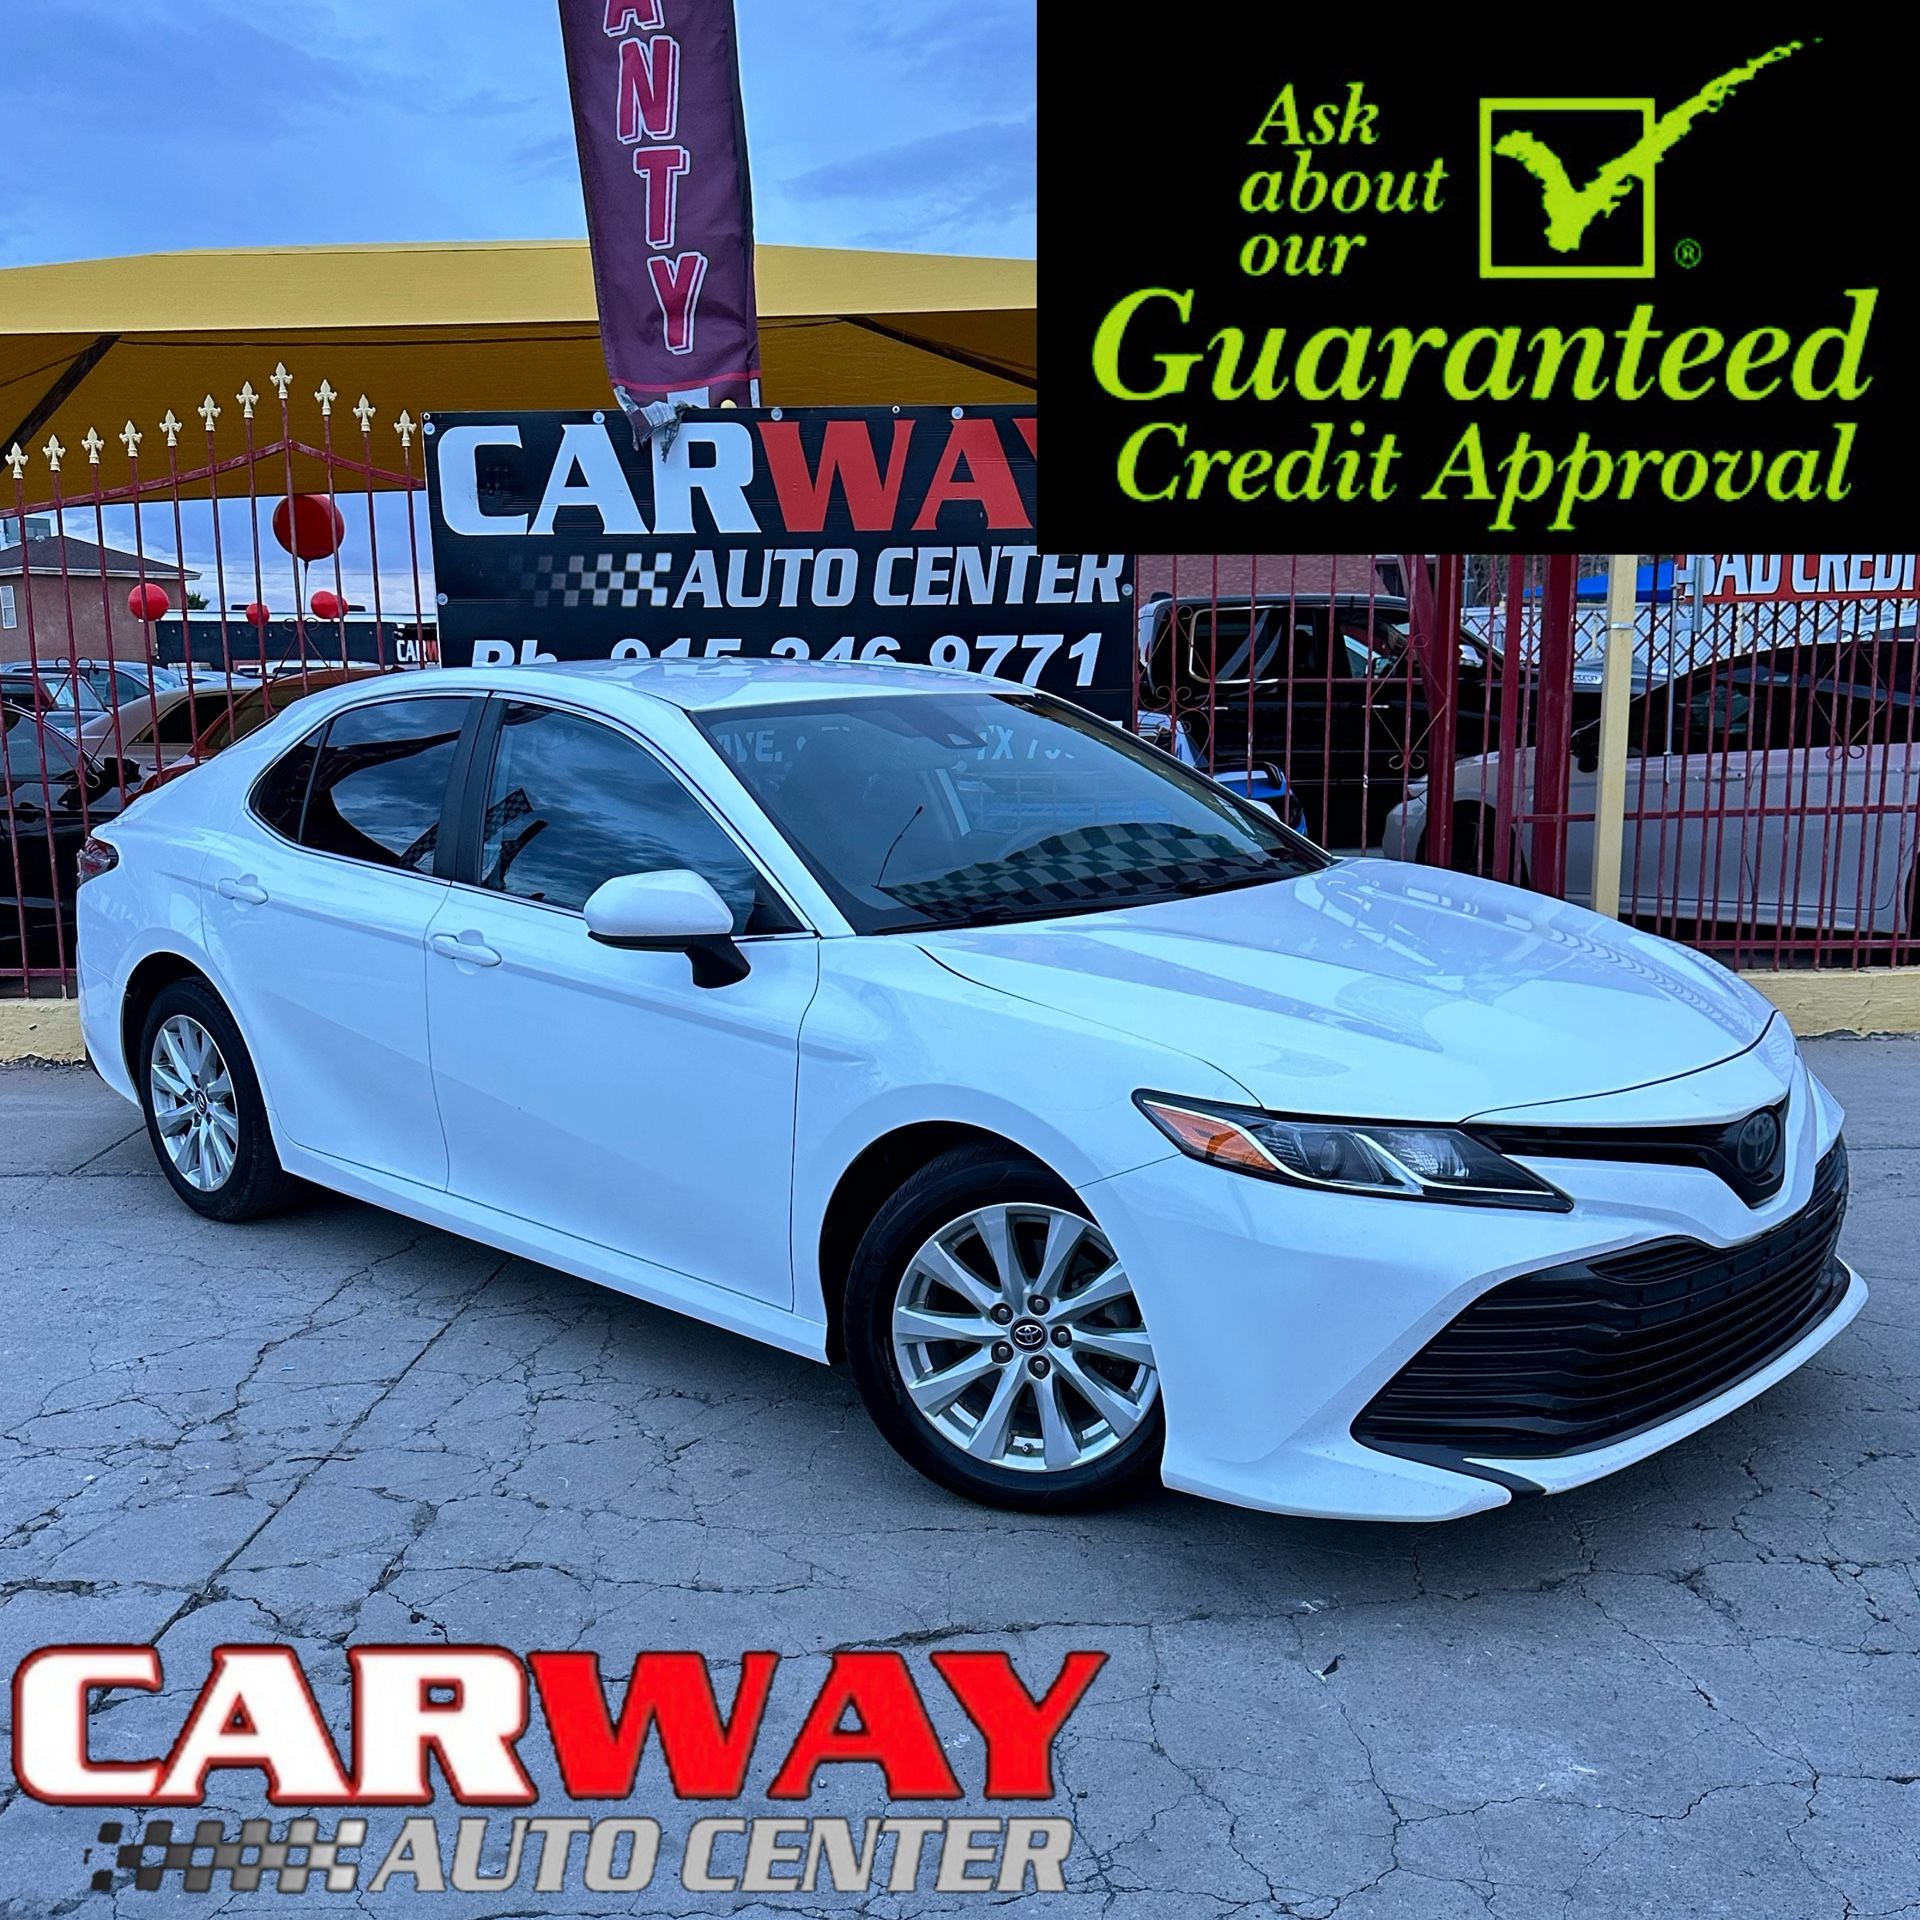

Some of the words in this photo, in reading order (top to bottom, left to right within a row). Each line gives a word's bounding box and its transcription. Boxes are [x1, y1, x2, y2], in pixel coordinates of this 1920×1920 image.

[436, 417, 1038, 537] CARWA
[672, 548, 860, 609] AUTO
[872, 544, 1125, 607] CENTER
[929, 632, 1103, 687] 9771
